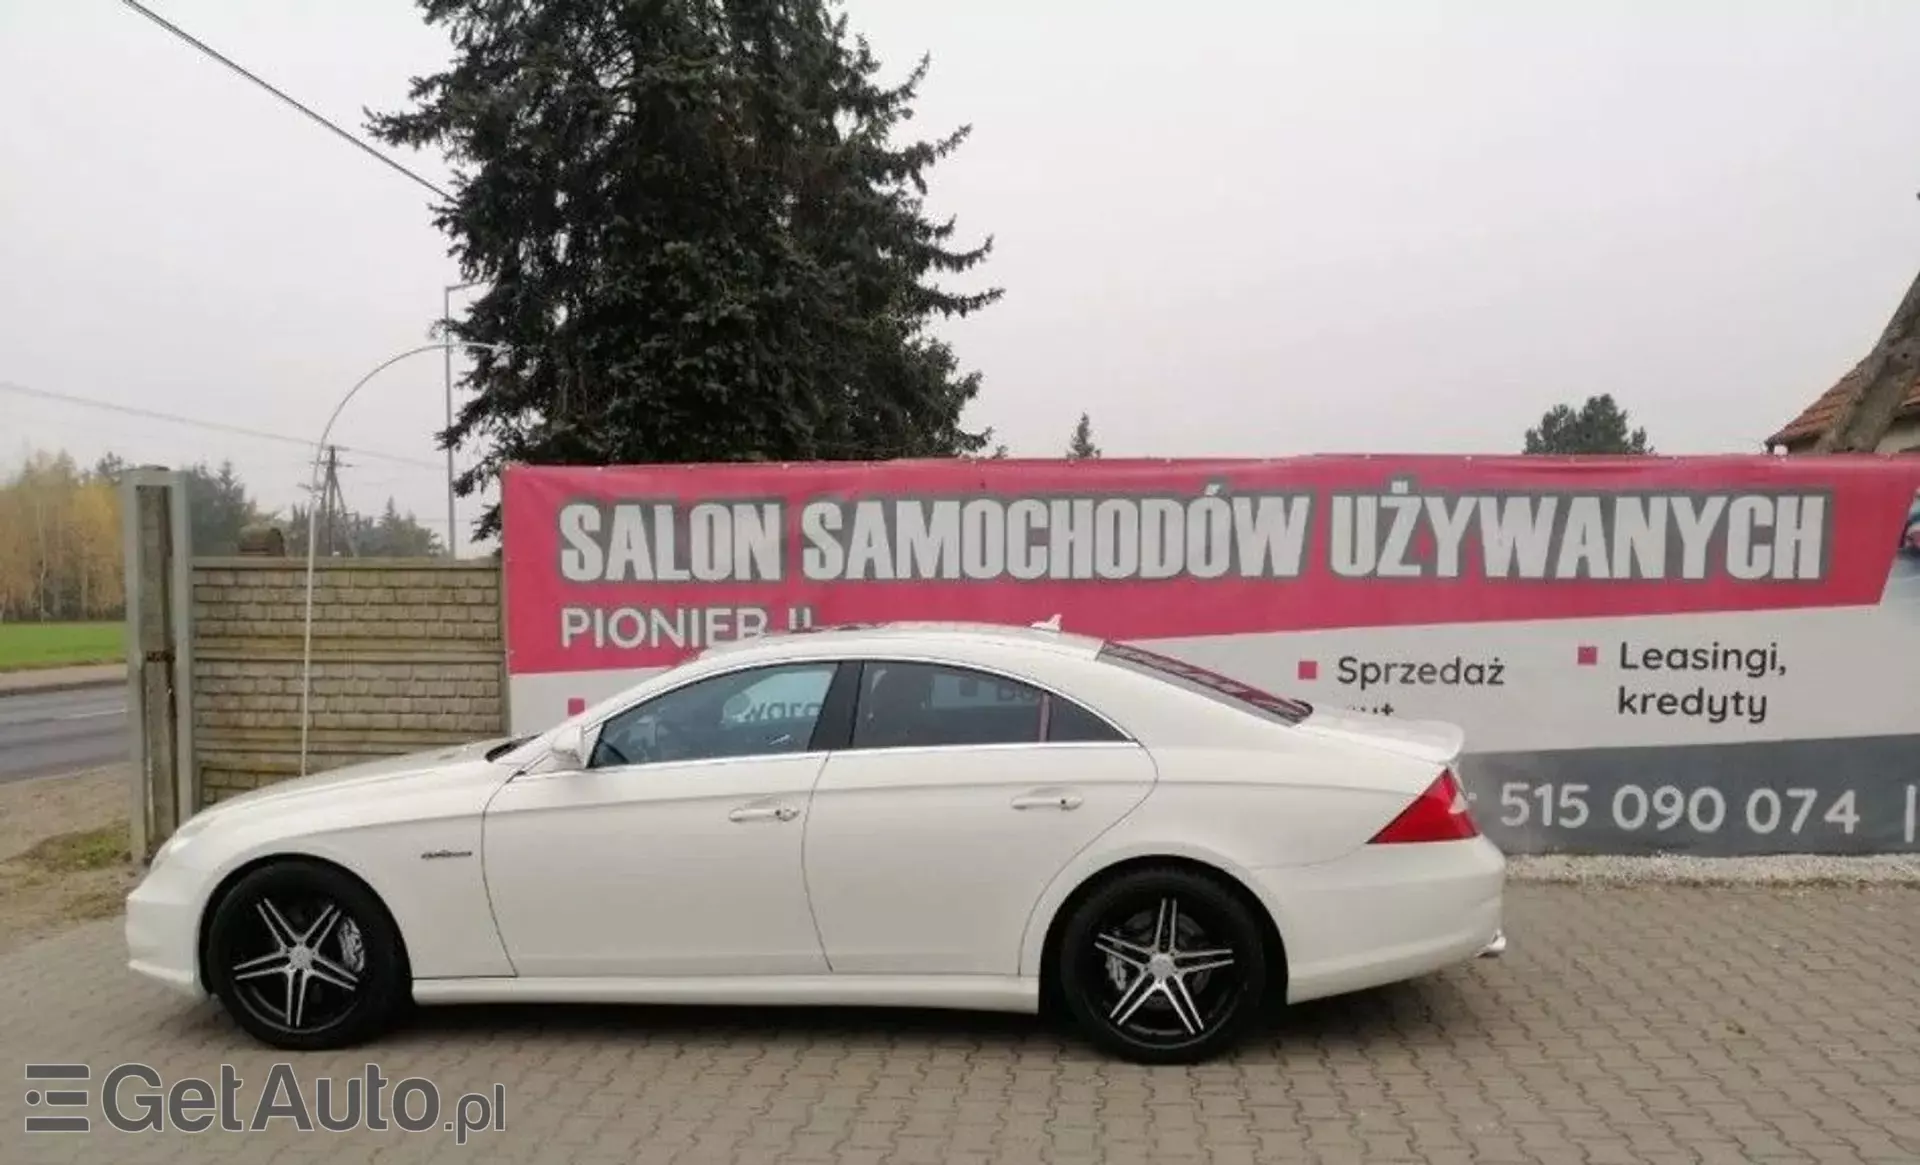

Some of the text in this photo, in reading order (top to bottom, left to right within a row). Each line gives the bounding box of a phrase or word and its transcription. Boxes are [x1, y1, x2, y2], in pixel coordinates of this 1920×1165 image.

[560, 480, 1826, 582] SALON SAMOCHODÓW UŻYWANYCH
[560, 606, 768, 649] PIONIER
[1336, 655, 1505, 691] Sprzedaż
[1618, 640, 1787, 679] Leasingi,
[1617, 685, 1768, 723] kredyty
[1500, 782, 1590, 829] 515
[1611, 783, 1726, 833] 090
[1745, 787, 1860, 834] 074
